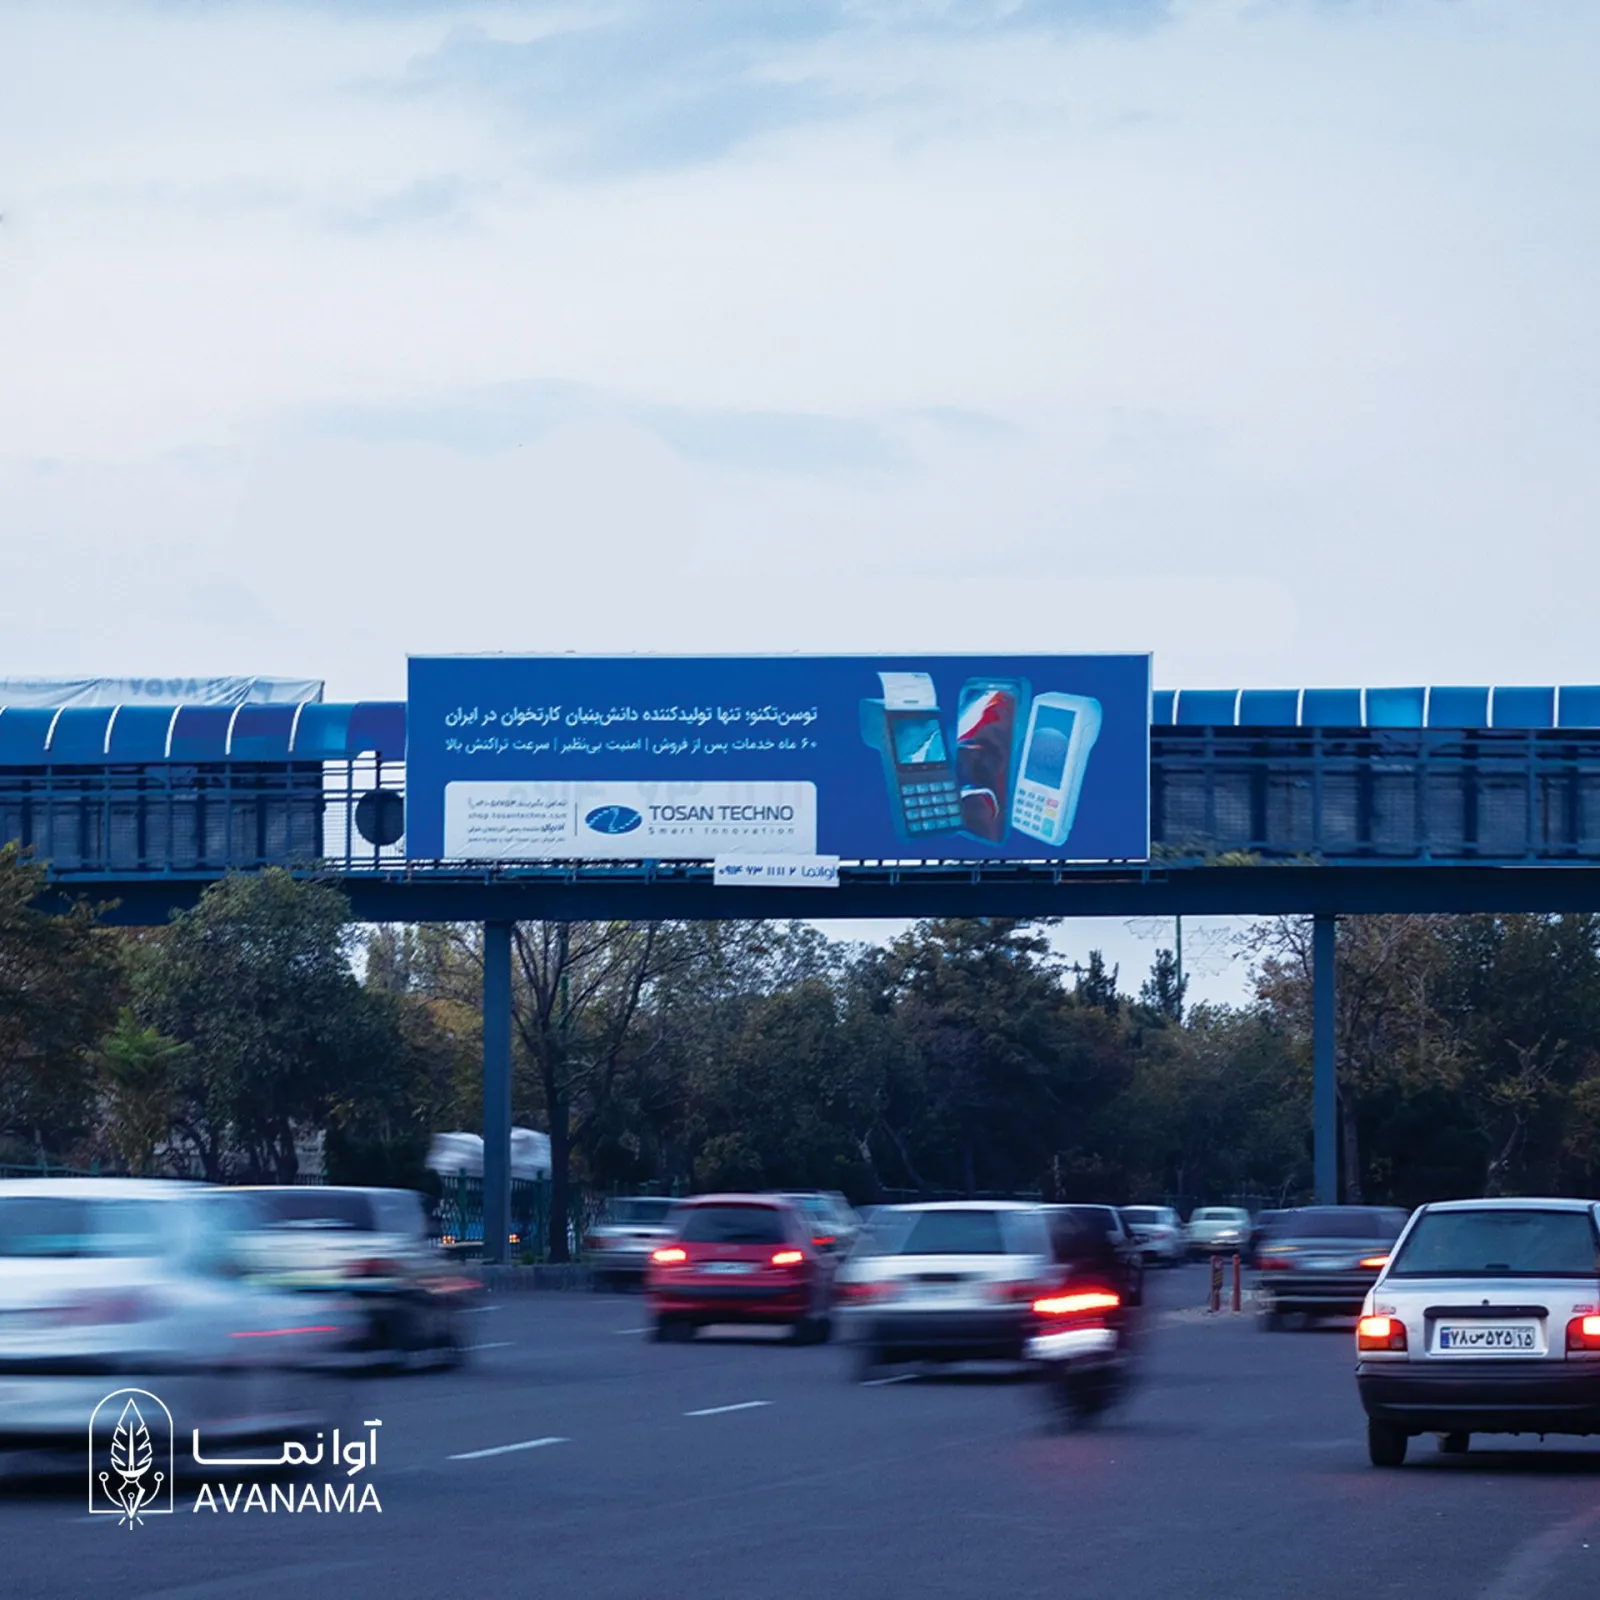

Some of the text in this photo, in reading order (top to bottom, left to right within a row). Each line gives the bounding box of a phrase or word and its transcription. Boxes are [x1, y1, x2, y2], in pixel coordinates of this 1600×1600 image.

[445, 706, 478, 727] ایران
[480, 708, 497, 726] در
[501, 705, 562, 727] کارتخوان
[717, 706, 742, 725] تنها
[445, 737, 463, 753] بالا
[465, 737, 509, 754] تراکنش
[511, 739, 550, 754] سرعت
[604, 738, 641, 752] امنیت
[652, 738, 689, 755] فروش
[690, 738, 701, 755] از
[704, 742, 728, 754] پس
[731, 738, 775, 750] خدمات
[778, 737, 797, 750] ماه
[648, 805, 794, 821] TOSAN TECHNO
[648, 826, 795, 835] Smart Innovation
